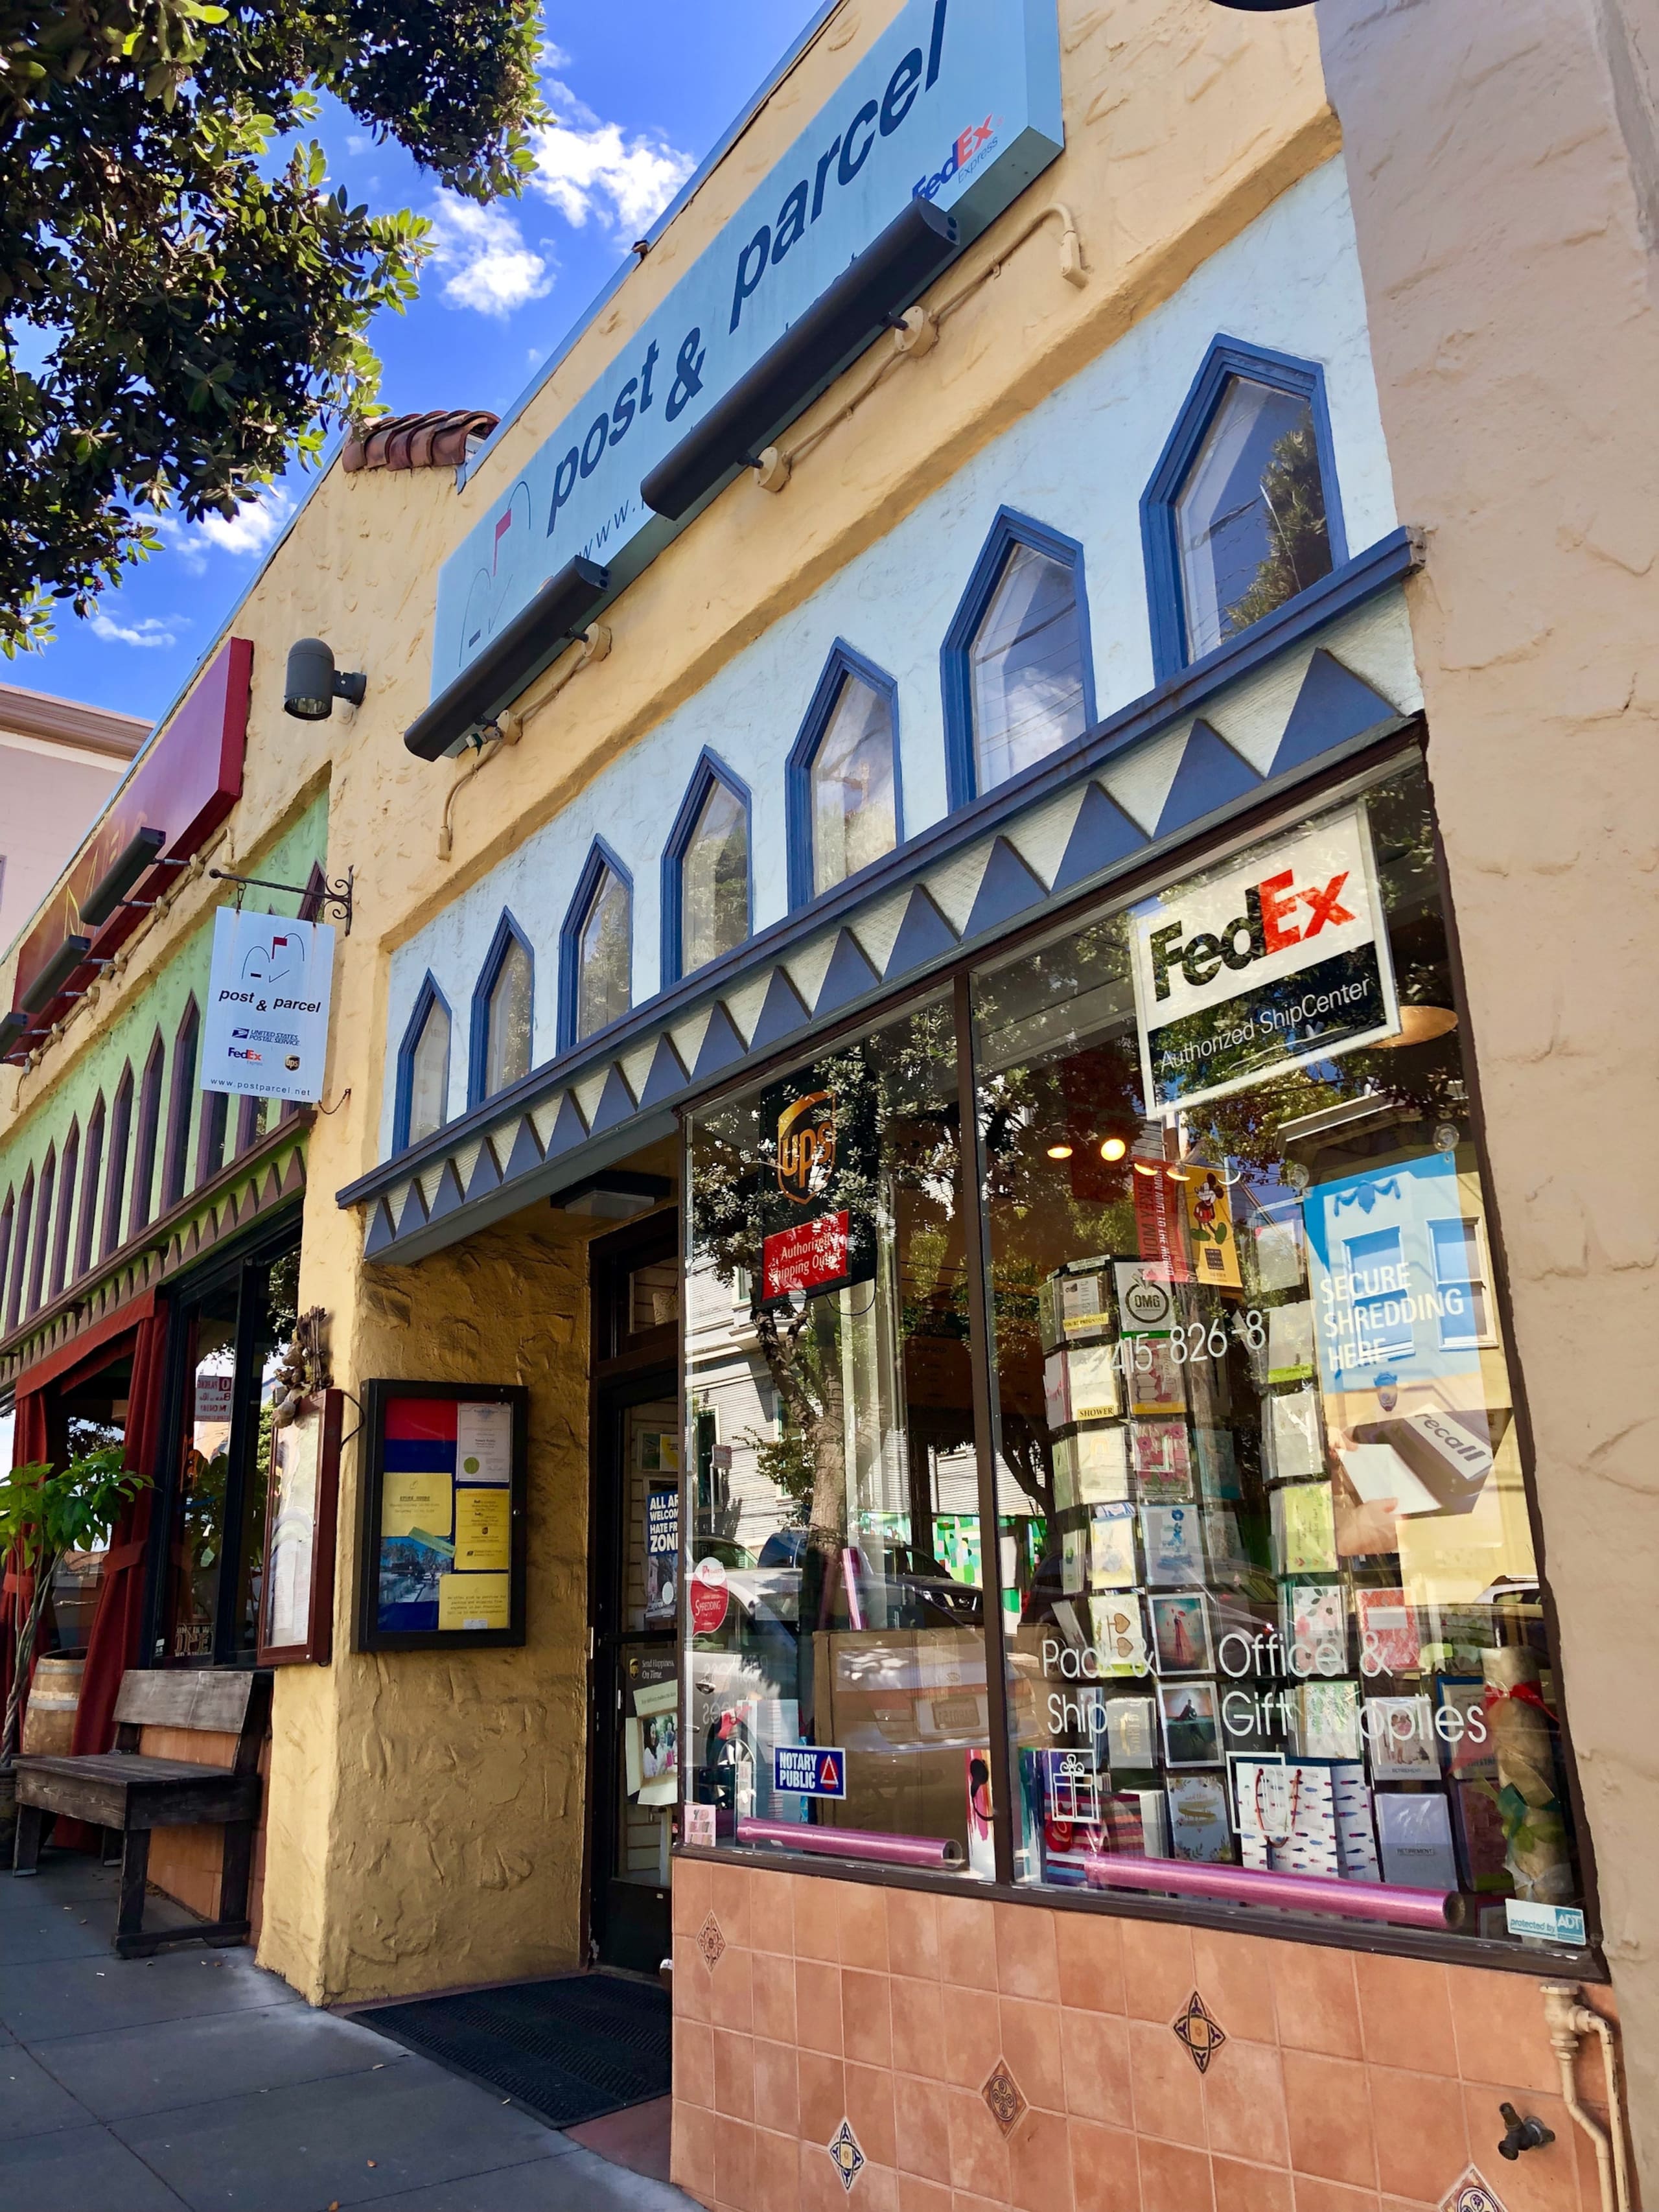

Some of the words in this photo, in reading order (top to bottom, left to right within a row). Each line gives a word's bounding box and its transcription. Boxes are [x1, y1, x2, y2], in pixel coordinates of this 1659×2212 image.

[912, 113, 993, 202] FedEx
[958, 136, 998, 183] Express
[547, 339, 660, 537] post
[666, 327, 707, 423] &
[728, 0, 946, 333] parcel
[1150, 868, 1356, 1002] FedEx
[218, 990, 255, 1005] post
[256, 999, 267, 1012] &
[273, 995, 321, 1013] parcel
[251, 1029, 275, 1038] UNITED
[274, 1038, 300, 1046] SERVICE
[1160, 1019, 1255, 1072] Authorized
[1259, 979, 1370, 1036] ShipCenter
[228, 1047, 262, 1061] FedEx
[781, 1122, 833, 1189] ups
[1135, 1294, 1161, 1308] OMG
[1320, 1261, 1412, 1305] SECURE
[1323, 1288, 1465, 1338] SHREDDING
[1328, 1337, 1389, 1373] HERE
[1080, 1407, 1114, 1417] SHOWER
[1415, 1413, 1487, 1464] recall
[649, 1497, 666, 1511] ALL
[668, 1494, 679, 1508] AR
[649, 1509, 679, 1522] WELCOM
[650, 1523, 668, 1535] HATE
[669, 1522, 678, 1533] FR
[1041, 1639, 1115, 1679] Pack
[1219, 1633, 1344, 1679] Office
[1360, 1631, 1394, 1679] &
[1047, 1693, 1108, 1743] Ship
[1222, 1690, 1288, 1738] Gift
[1341, 1693, 1488, 1752] pplies
[780, 1752, 817, 1771] NOTARY
[780, 1769, 815, 1789] PUBLIC
[1511, 1918, 1546, 1930] protected
[1547, 1923, 1555, 1933] by
[1557, 1914, 1581, 1930] ADT
